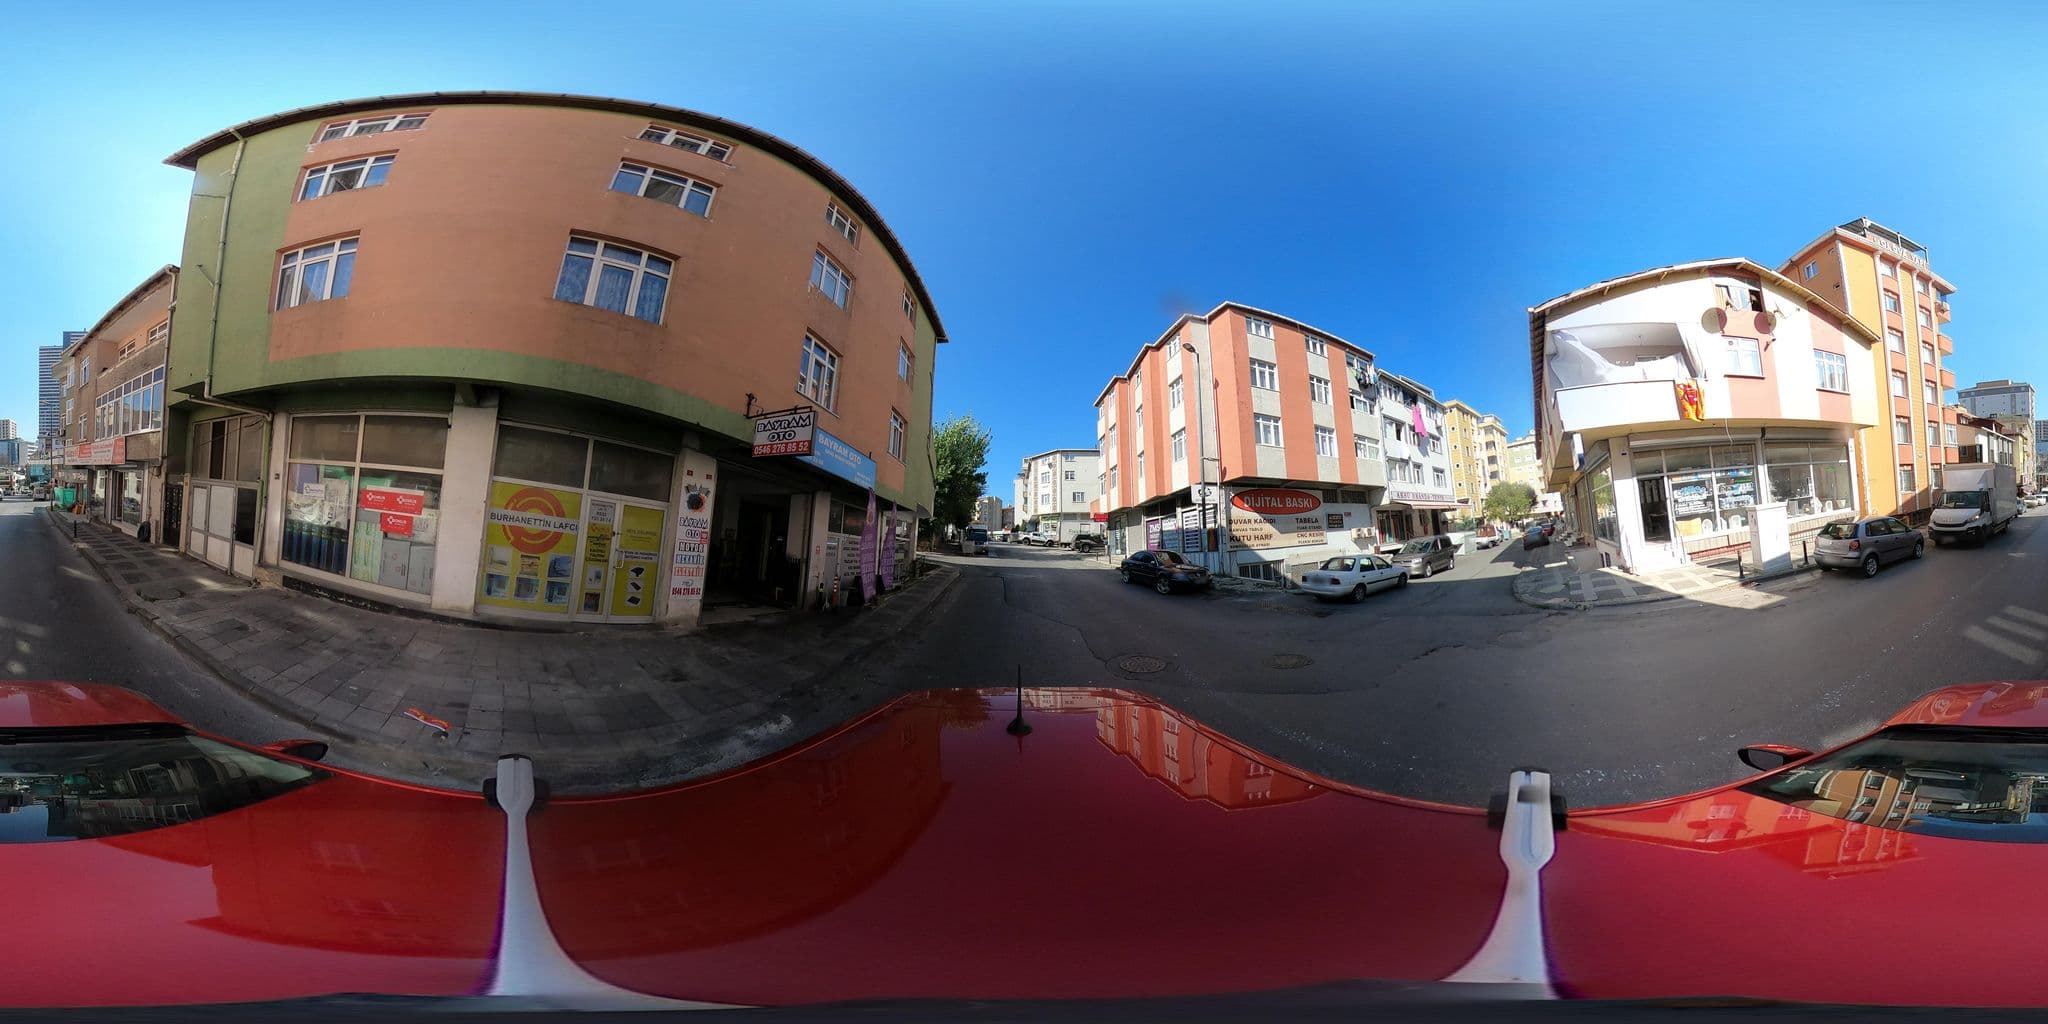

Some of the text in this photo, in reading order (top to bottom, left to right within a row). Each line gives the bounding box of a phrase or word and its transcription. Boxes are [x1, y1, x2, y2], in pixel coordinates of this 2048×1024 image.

[757, 414, 811, 432] BAYRAM
[768, 430, 796, 442] OTO
[754, 441, 809, 455] 0546 276 85 52
[818, 433, 849, 457] BAYRAM
[849, 451, 862, 465] OTO
[1244, 494, 1313, 508] DİJİTAL BASKI
[490, 512, 551, 528] BURHANETTİN
[679, 516, 709, 529] BAYRAM
[686, 529, 701, 539] OTO
[1229, 533, 1273, 543] KUTU HARF
[678, 542, 705, 553] MOTOR
